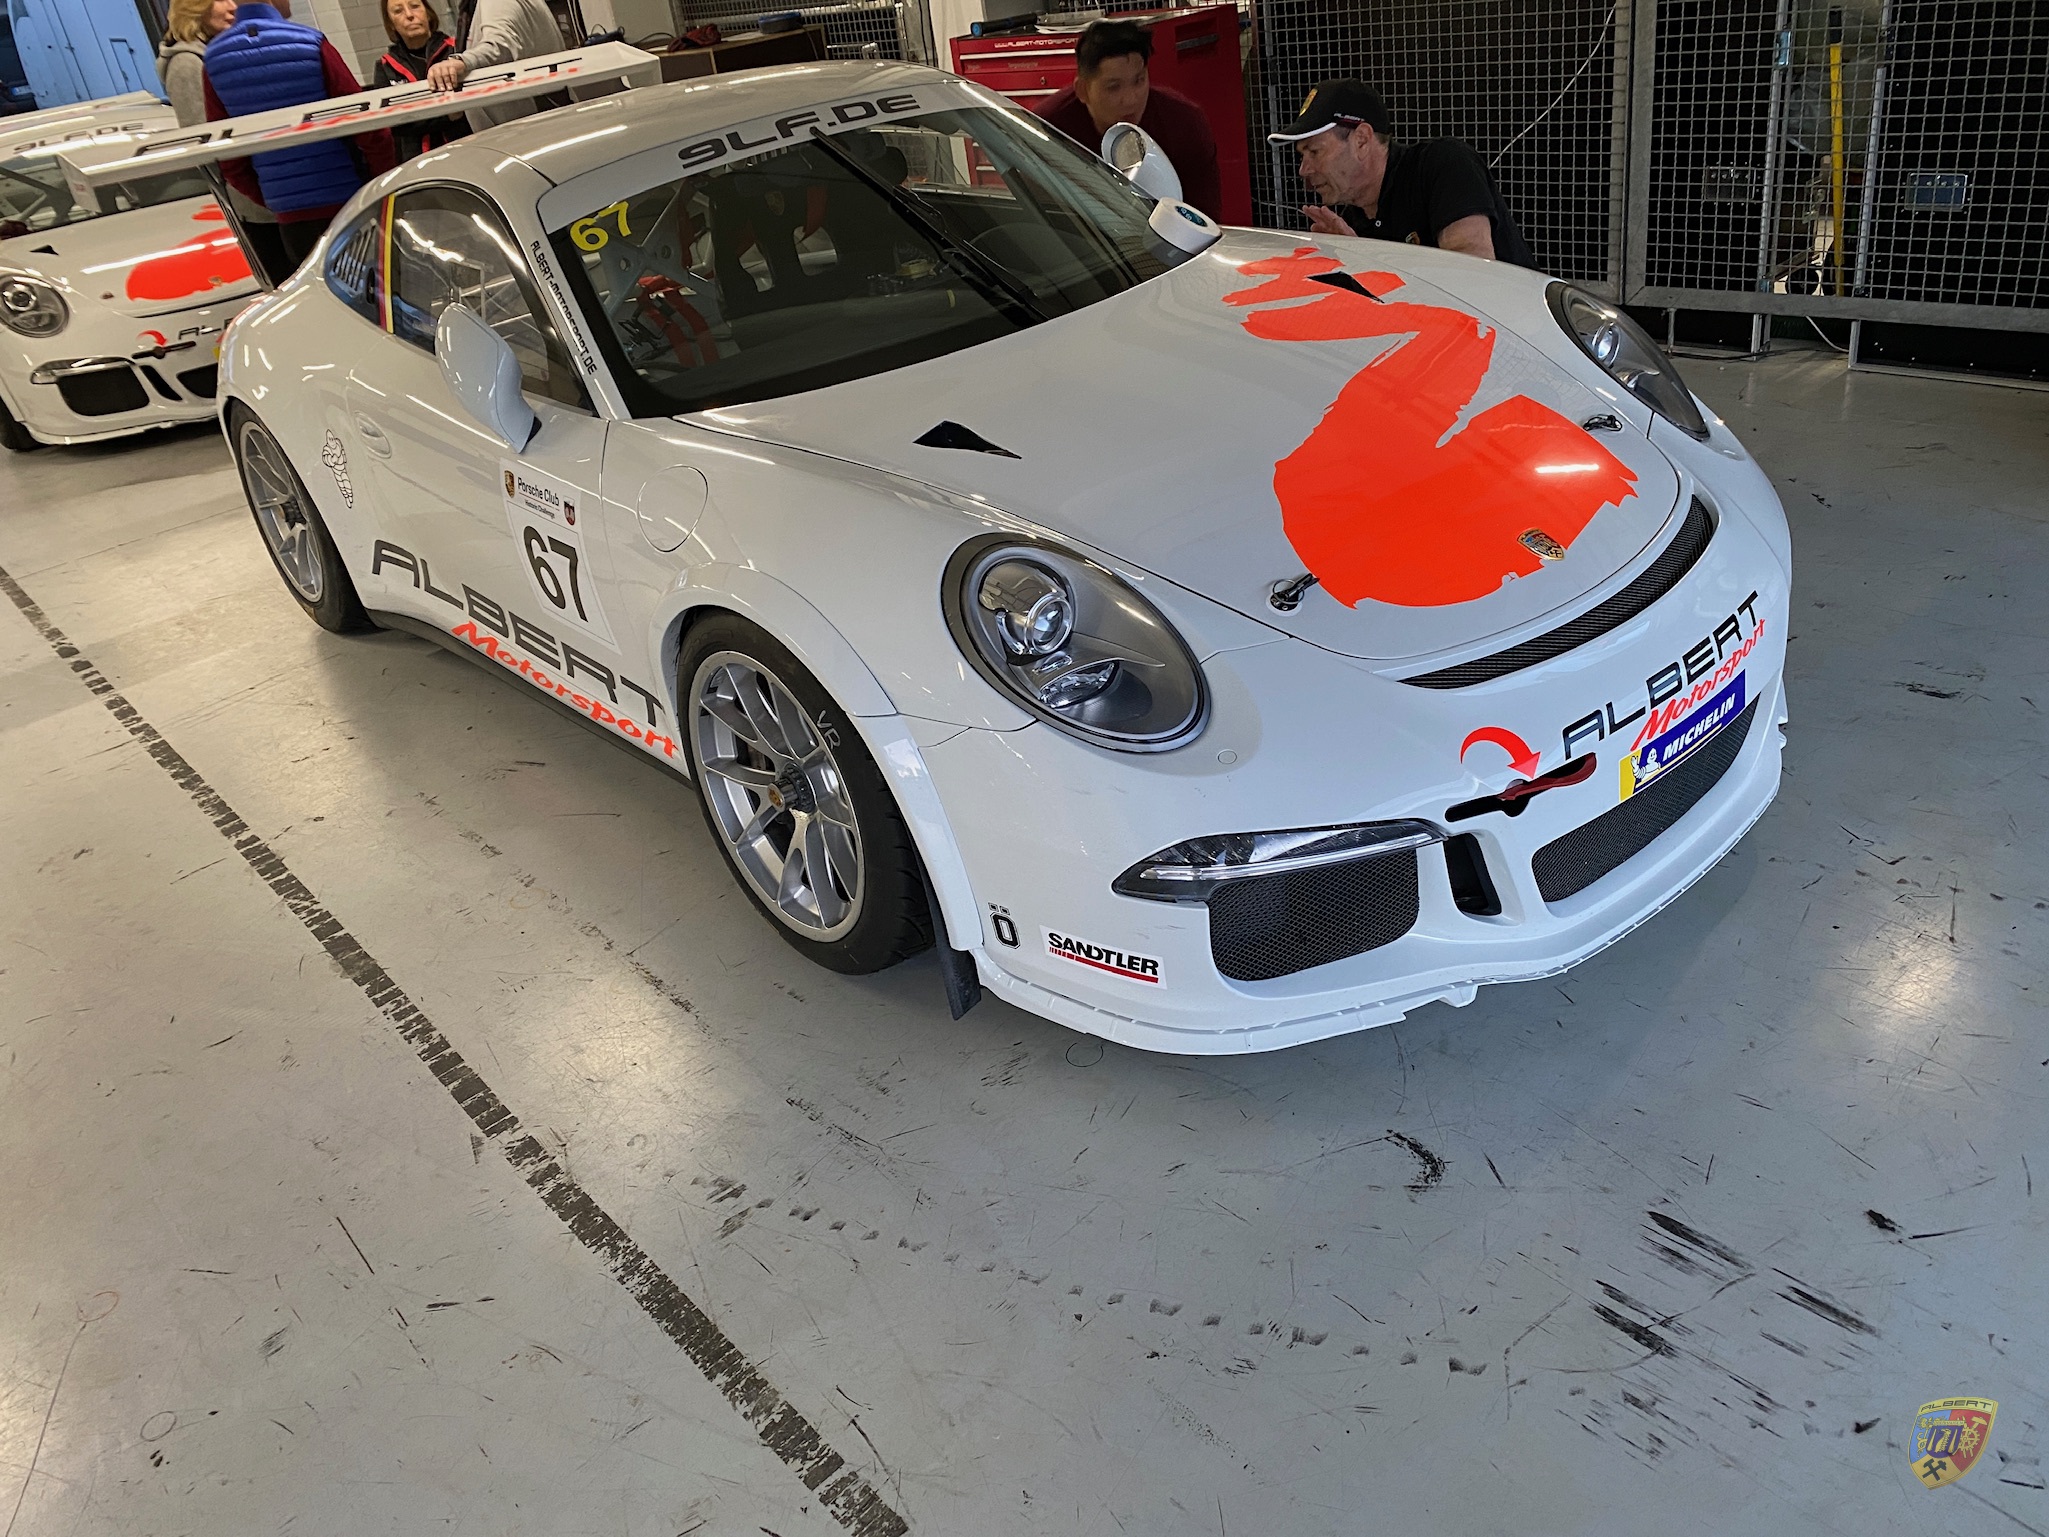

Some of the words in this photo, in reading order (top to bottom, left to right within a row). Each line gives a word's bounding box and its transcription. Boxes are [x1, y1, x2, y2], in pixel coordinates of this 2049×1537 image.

[677, 94, 921, 170] 9LF.DE
[569, 200, 633, 251] 67
[517, 476, 544, 500] Porsche
[543, 488, 560, 507] Club
[523, 525, 589, 623] 67
[372, 539, 667, 728] ALBERT
[1562, 590, 1758, 760] ALBERT
[451, 620, 680, 760] Motorsport
[1630, 618, 1766, 751] Motorsport
[1662, 693, 1736, 762] MICHELIN
[1048, 932, 1159, 976] SANDTLER
